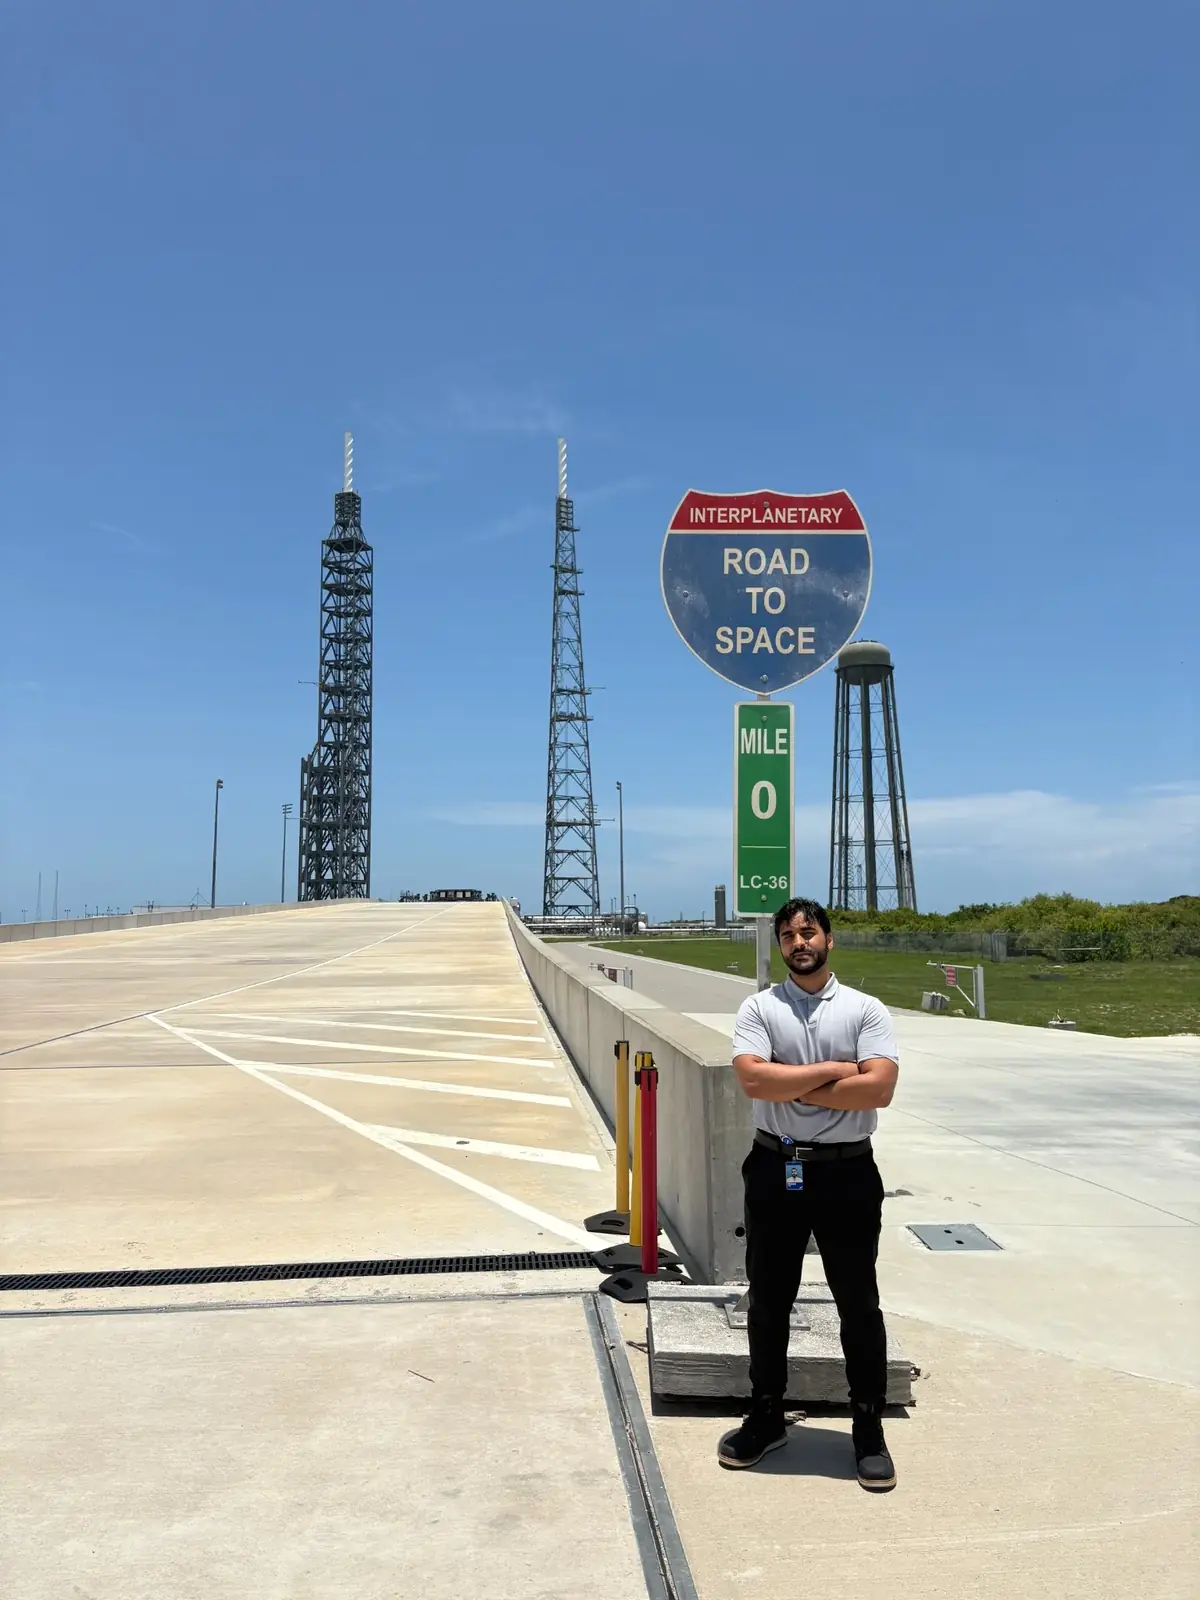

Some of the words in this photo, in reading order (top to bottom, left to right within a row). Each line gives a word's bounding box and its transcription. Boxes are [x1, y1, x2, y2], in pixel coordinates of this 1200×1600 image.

[690, 507, 843, 524] INTERPLANETARY
[723, 548, 810, 575] ROAD
[745, 587, 786, 614] TO
[715, 626, 816, 655] SPACE
[741, 728, 788, 755] MILE
[751, 780, 777, 820] 0
[740, 875, 788, 889] LC-36
